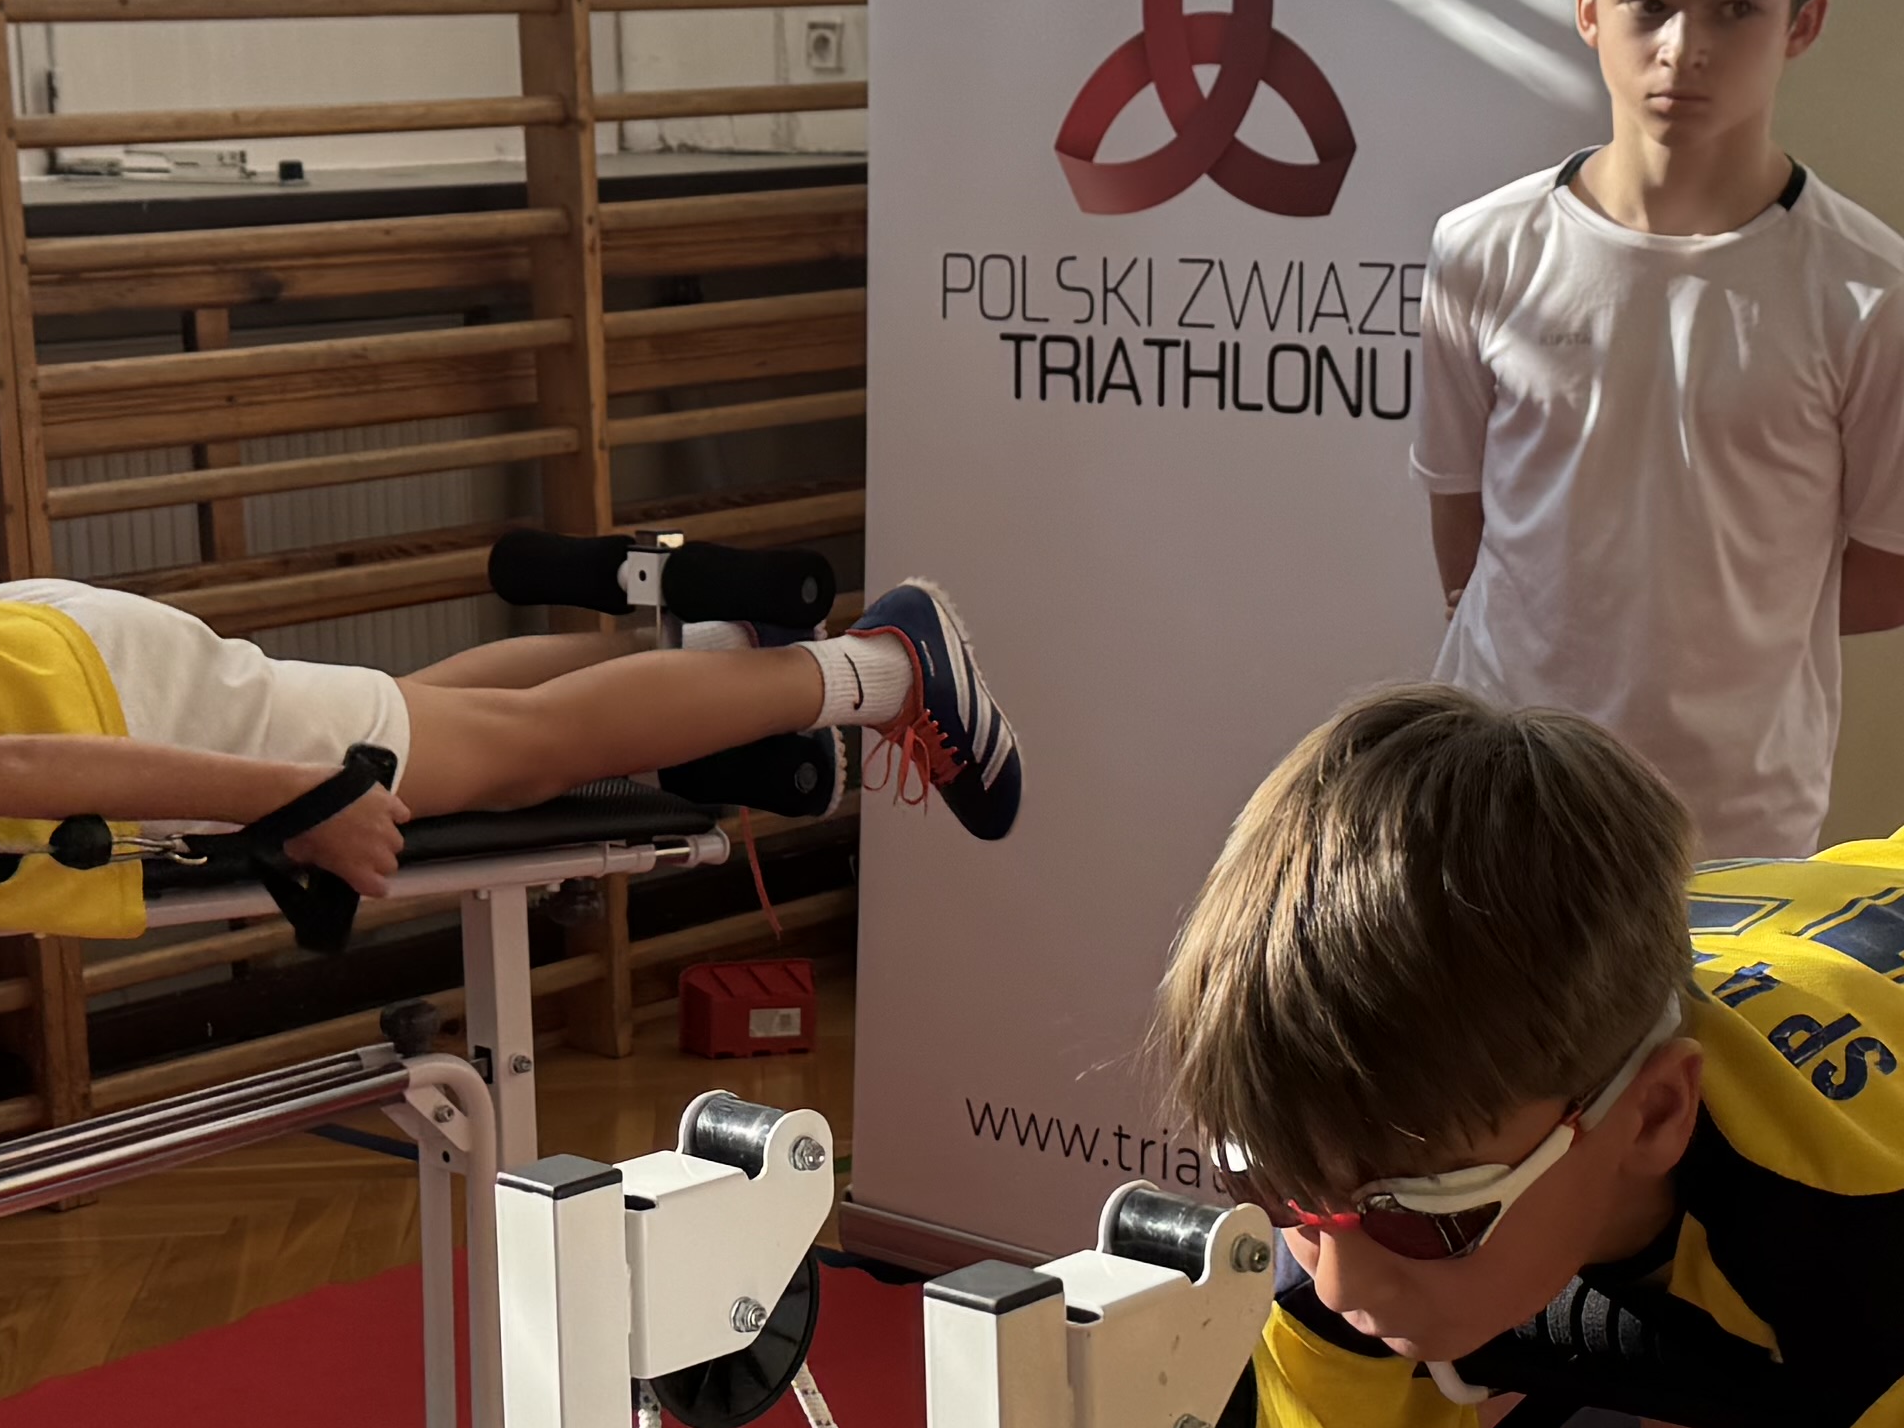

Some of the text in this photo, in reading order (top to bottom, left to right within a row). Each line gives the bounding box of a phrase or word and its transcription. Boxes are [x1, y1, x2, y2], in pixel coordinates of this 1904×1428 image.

[941, 252, 1427, 338] POLSKI ZWIĄZE
[999, 332, 1412, 420] TRIATHLONU
[1767, 1012, 1897, 1100] SP
[965, 1097, 1226, 1193] www.tria
